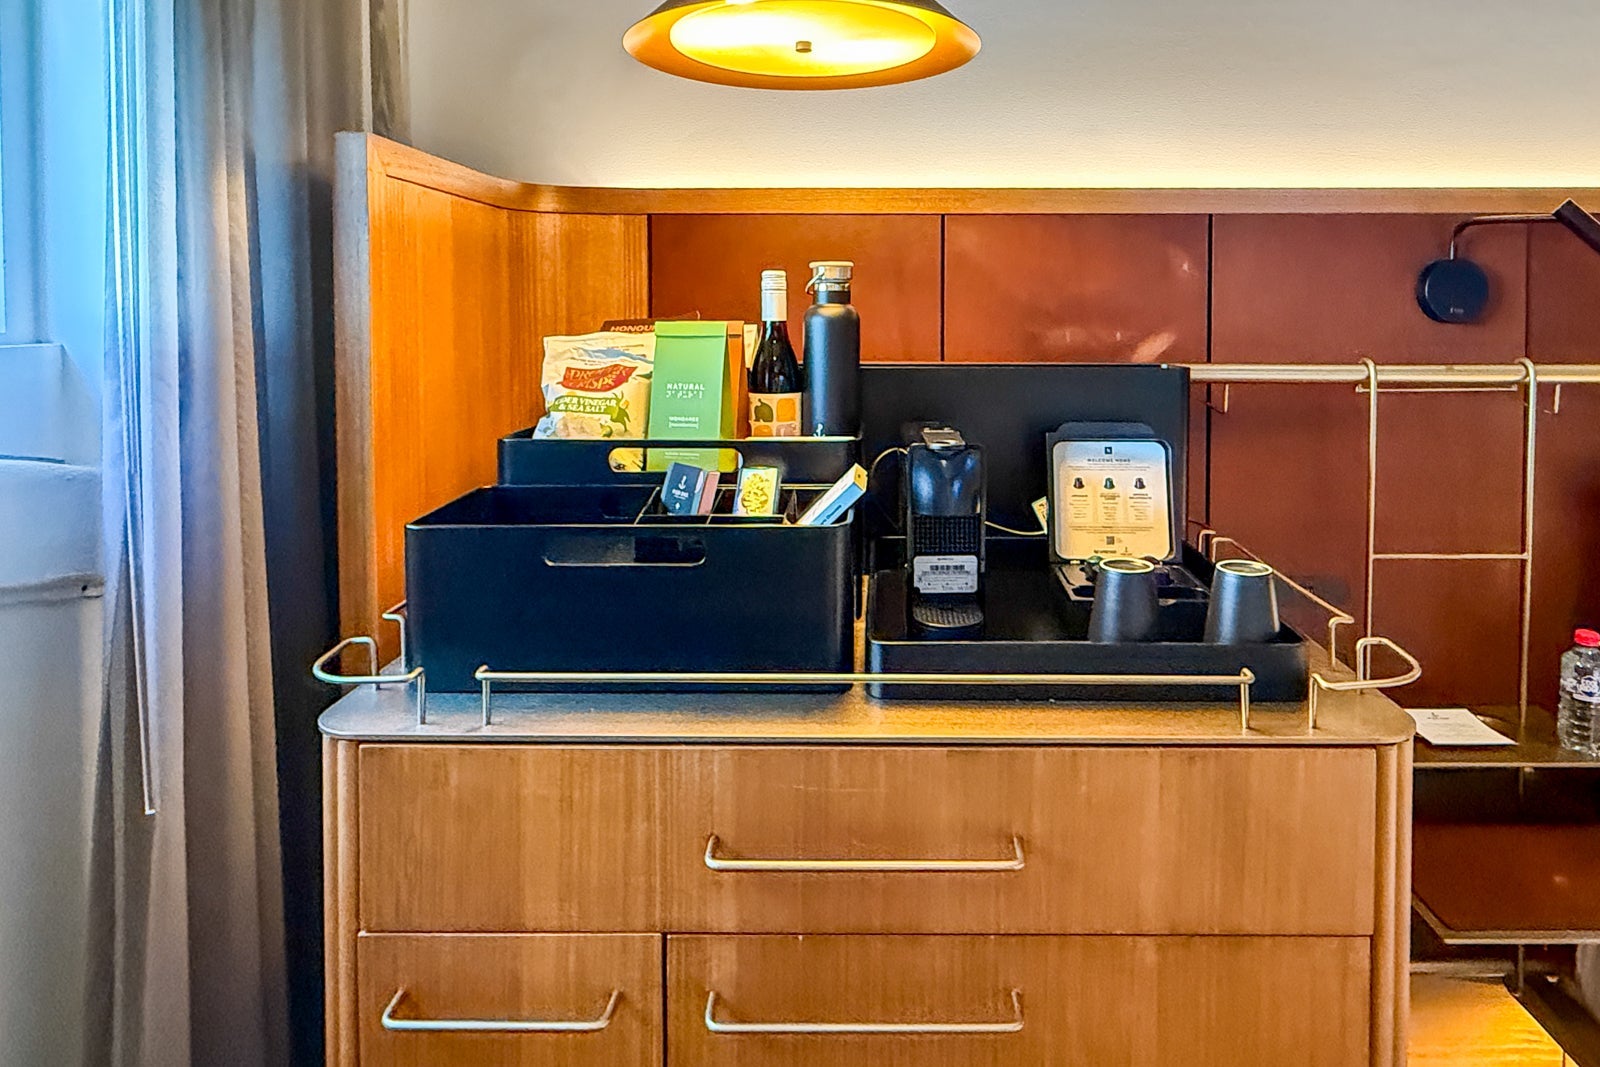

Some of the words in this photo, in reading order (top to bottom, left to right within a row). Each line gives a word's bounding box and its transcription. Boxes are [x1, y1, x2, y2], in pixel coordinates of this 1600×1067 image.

[666, 383, 705, 391] NATURAL
[555, 396, 578, 405] CIDER
[579, 397, 617, 407] VINEGAR
[558, 403, 566, 411] &
[567, 404, 584, 412] SEA
[585, 405, 607, 413] SALT
